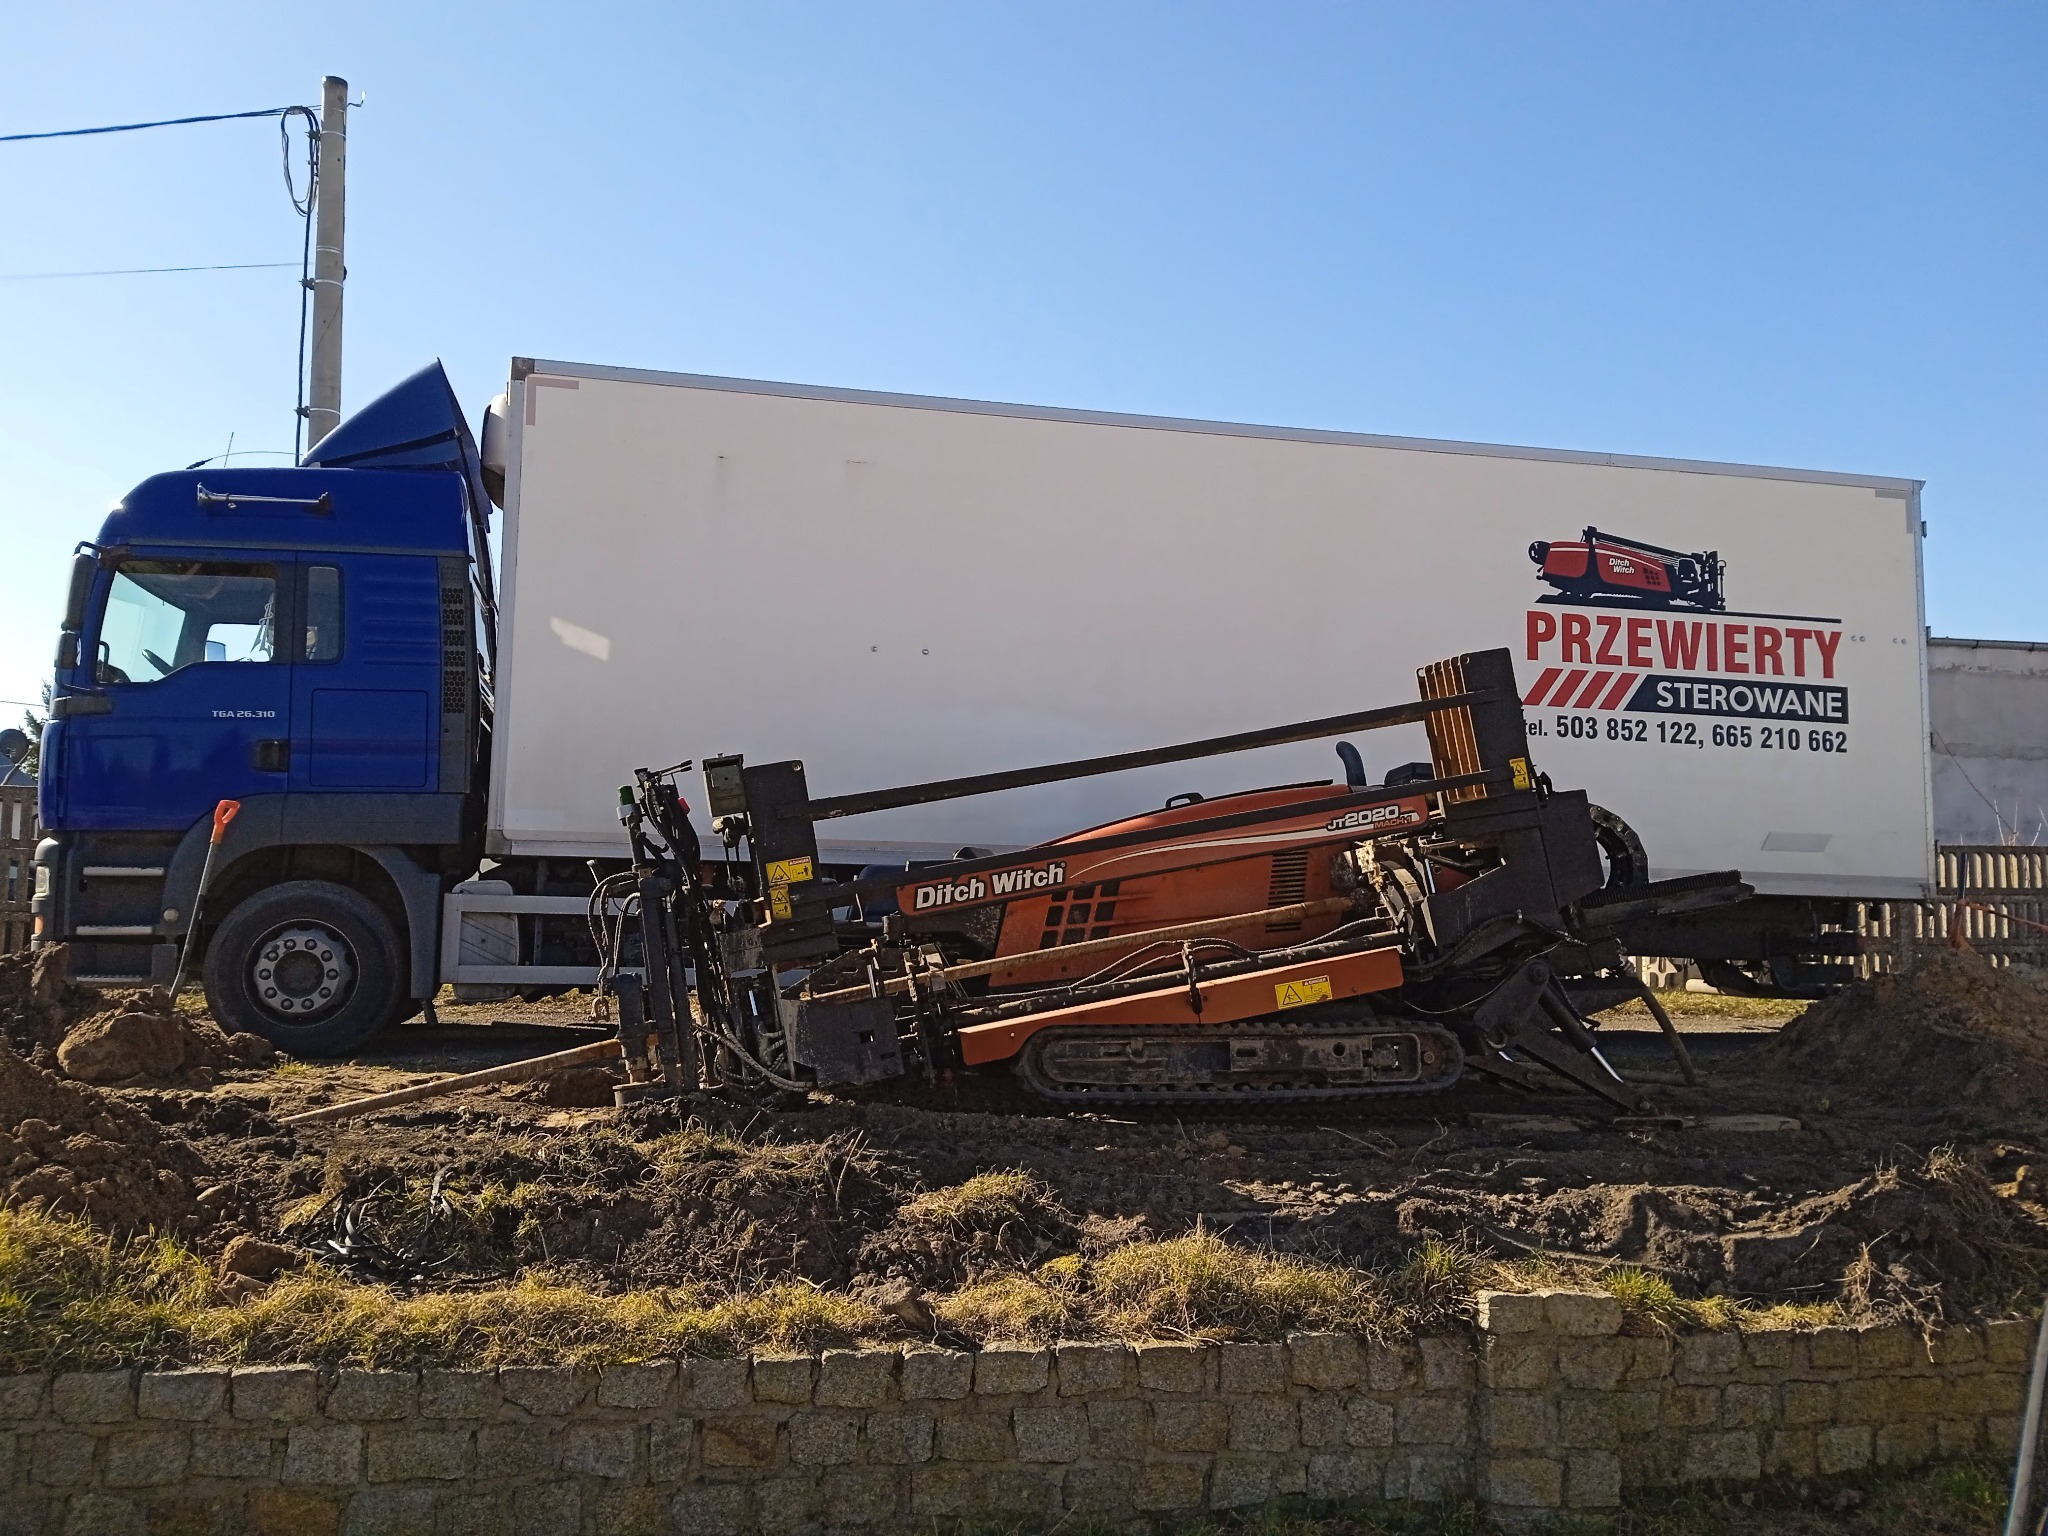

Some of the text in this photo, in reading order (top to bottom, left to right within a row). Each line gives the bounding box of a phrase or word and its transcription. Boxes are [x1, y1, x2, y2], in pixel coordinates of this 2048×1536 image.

[1609, 558, 1630, 566] Ditch
[1613, 565, 1635, 574] Witch
[1526, 610, 1843, 679] PRZEWIERTY
[1656, 681, 1843, 718] STEROWANE
[211, 710, 276, 718] TGA 26.310
[1556, 714, 1598, 740] 503
[1606, 717, 1648, 742] 852
[1656, 720, 1704, 750] 122,
[1712, 724, 1753, 748] 665
[1760, 726, 1801, 751] 210
[1808, 729, 1848, 753] 662
[1327, 805, 1399, 831] JT2020
[915, 878, 986, 909] Ditch
